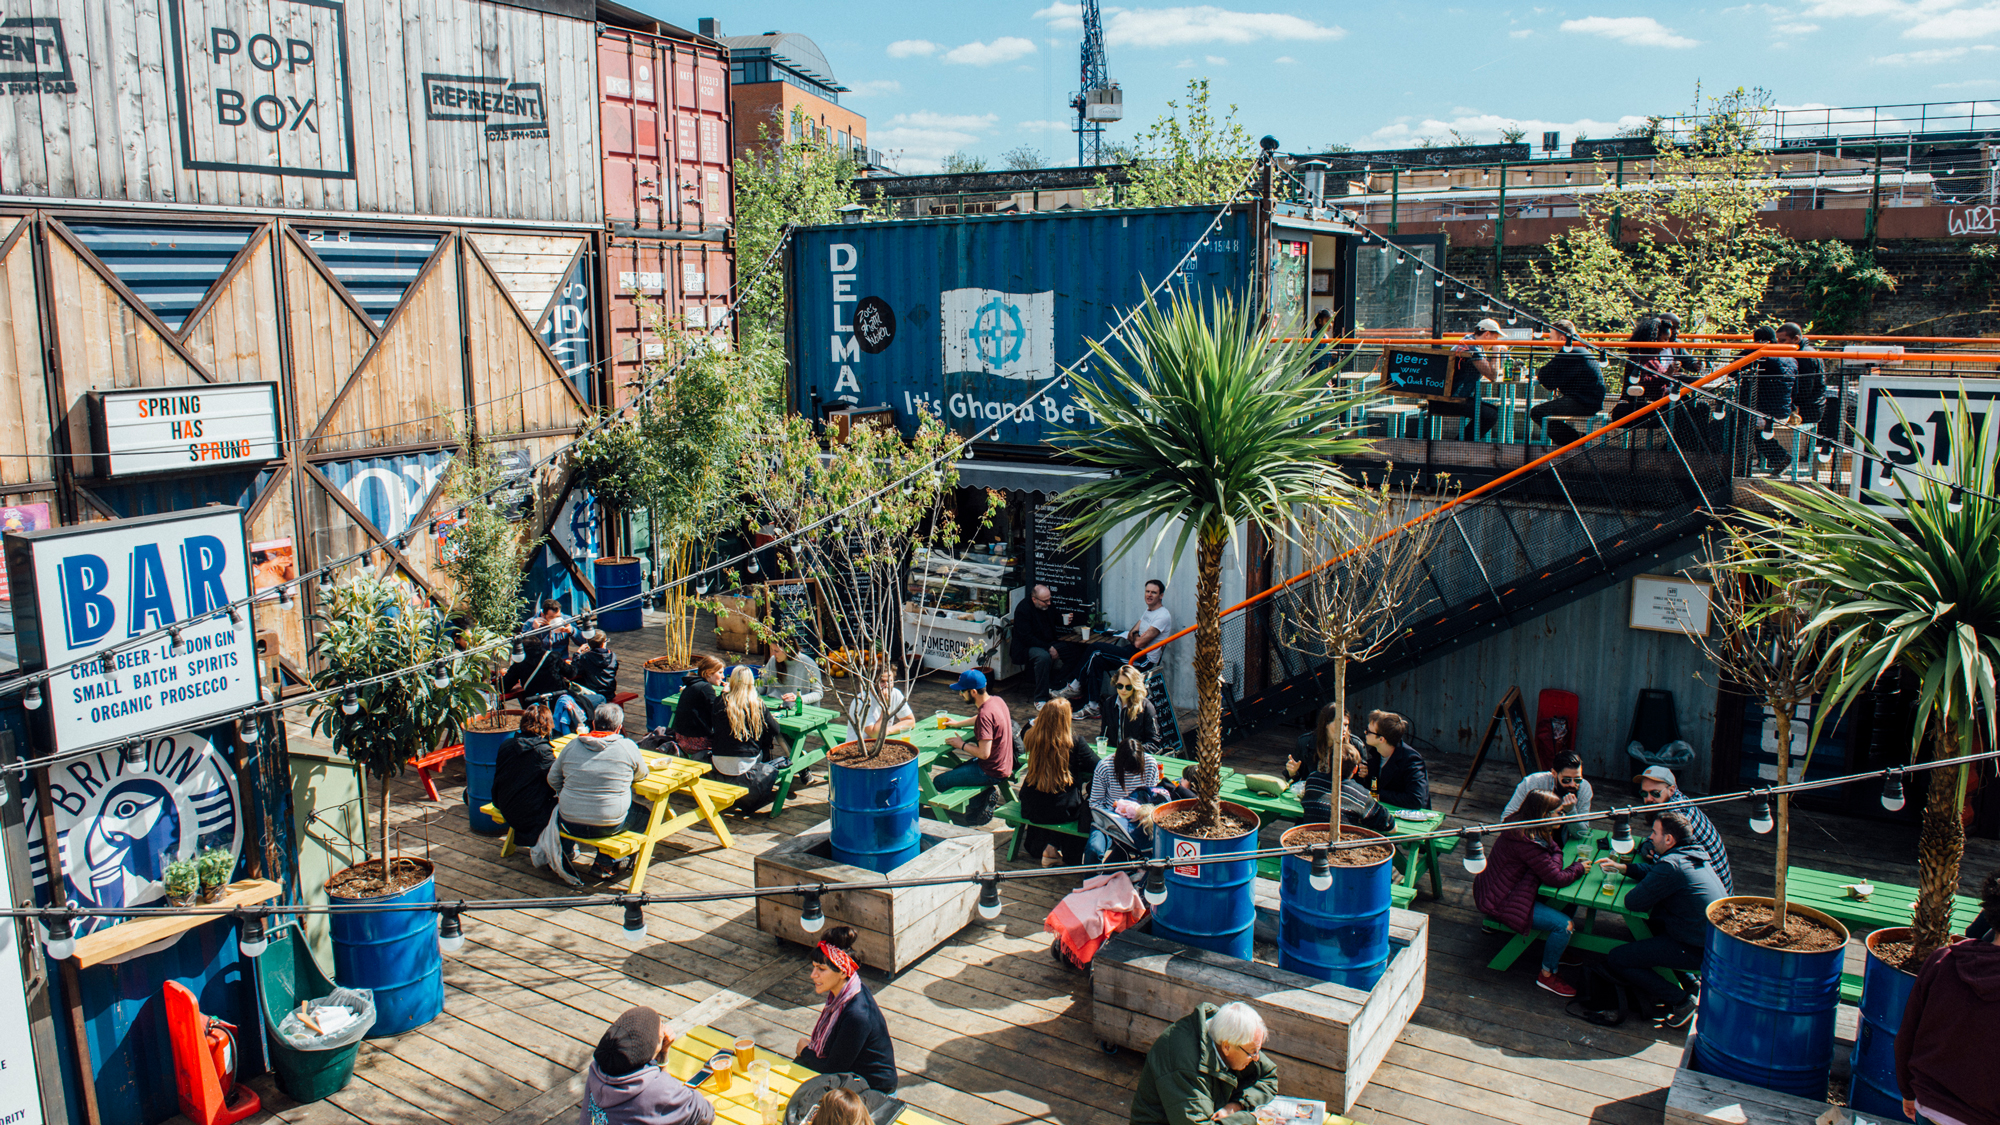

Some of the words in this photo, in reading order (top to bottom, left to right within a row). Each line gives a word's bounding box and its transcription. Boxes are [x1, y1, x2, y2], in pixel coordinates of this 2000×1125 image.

[211, 27, 314, 74] POP
[216, 88, 318, 134] BOX
[432, 84, 538, 119] REPREZENT
[1395, 353, 1429, 366] Beers
[1425, 377, 1445, 388] Food
[138, 395, 201, 418] SPRING
[904, 391, 943, 417] It's
[949, 392, 1035, 421] Ghana
[1046, 397, 1075, 423] Be
[171, 420, 204, 440] HAS
[189, 439, 250, 462] SPRUNG
[57, 535, 229, 651] BAR
[71, 656, 110, 680] CRA
[117, 649, 150, 670] BEER
[161, 634, 211, 660] LODON
[214, 630, 236, 648] GIN
[73, 679, 122, 703] SMALL
[133, 665, 178, 690] BATCH
[187, 651, 239, 677] SPIRITS
[91, 695, 153, 724] ORGANIC
[160, 676, 228, 706] PROSECCO
